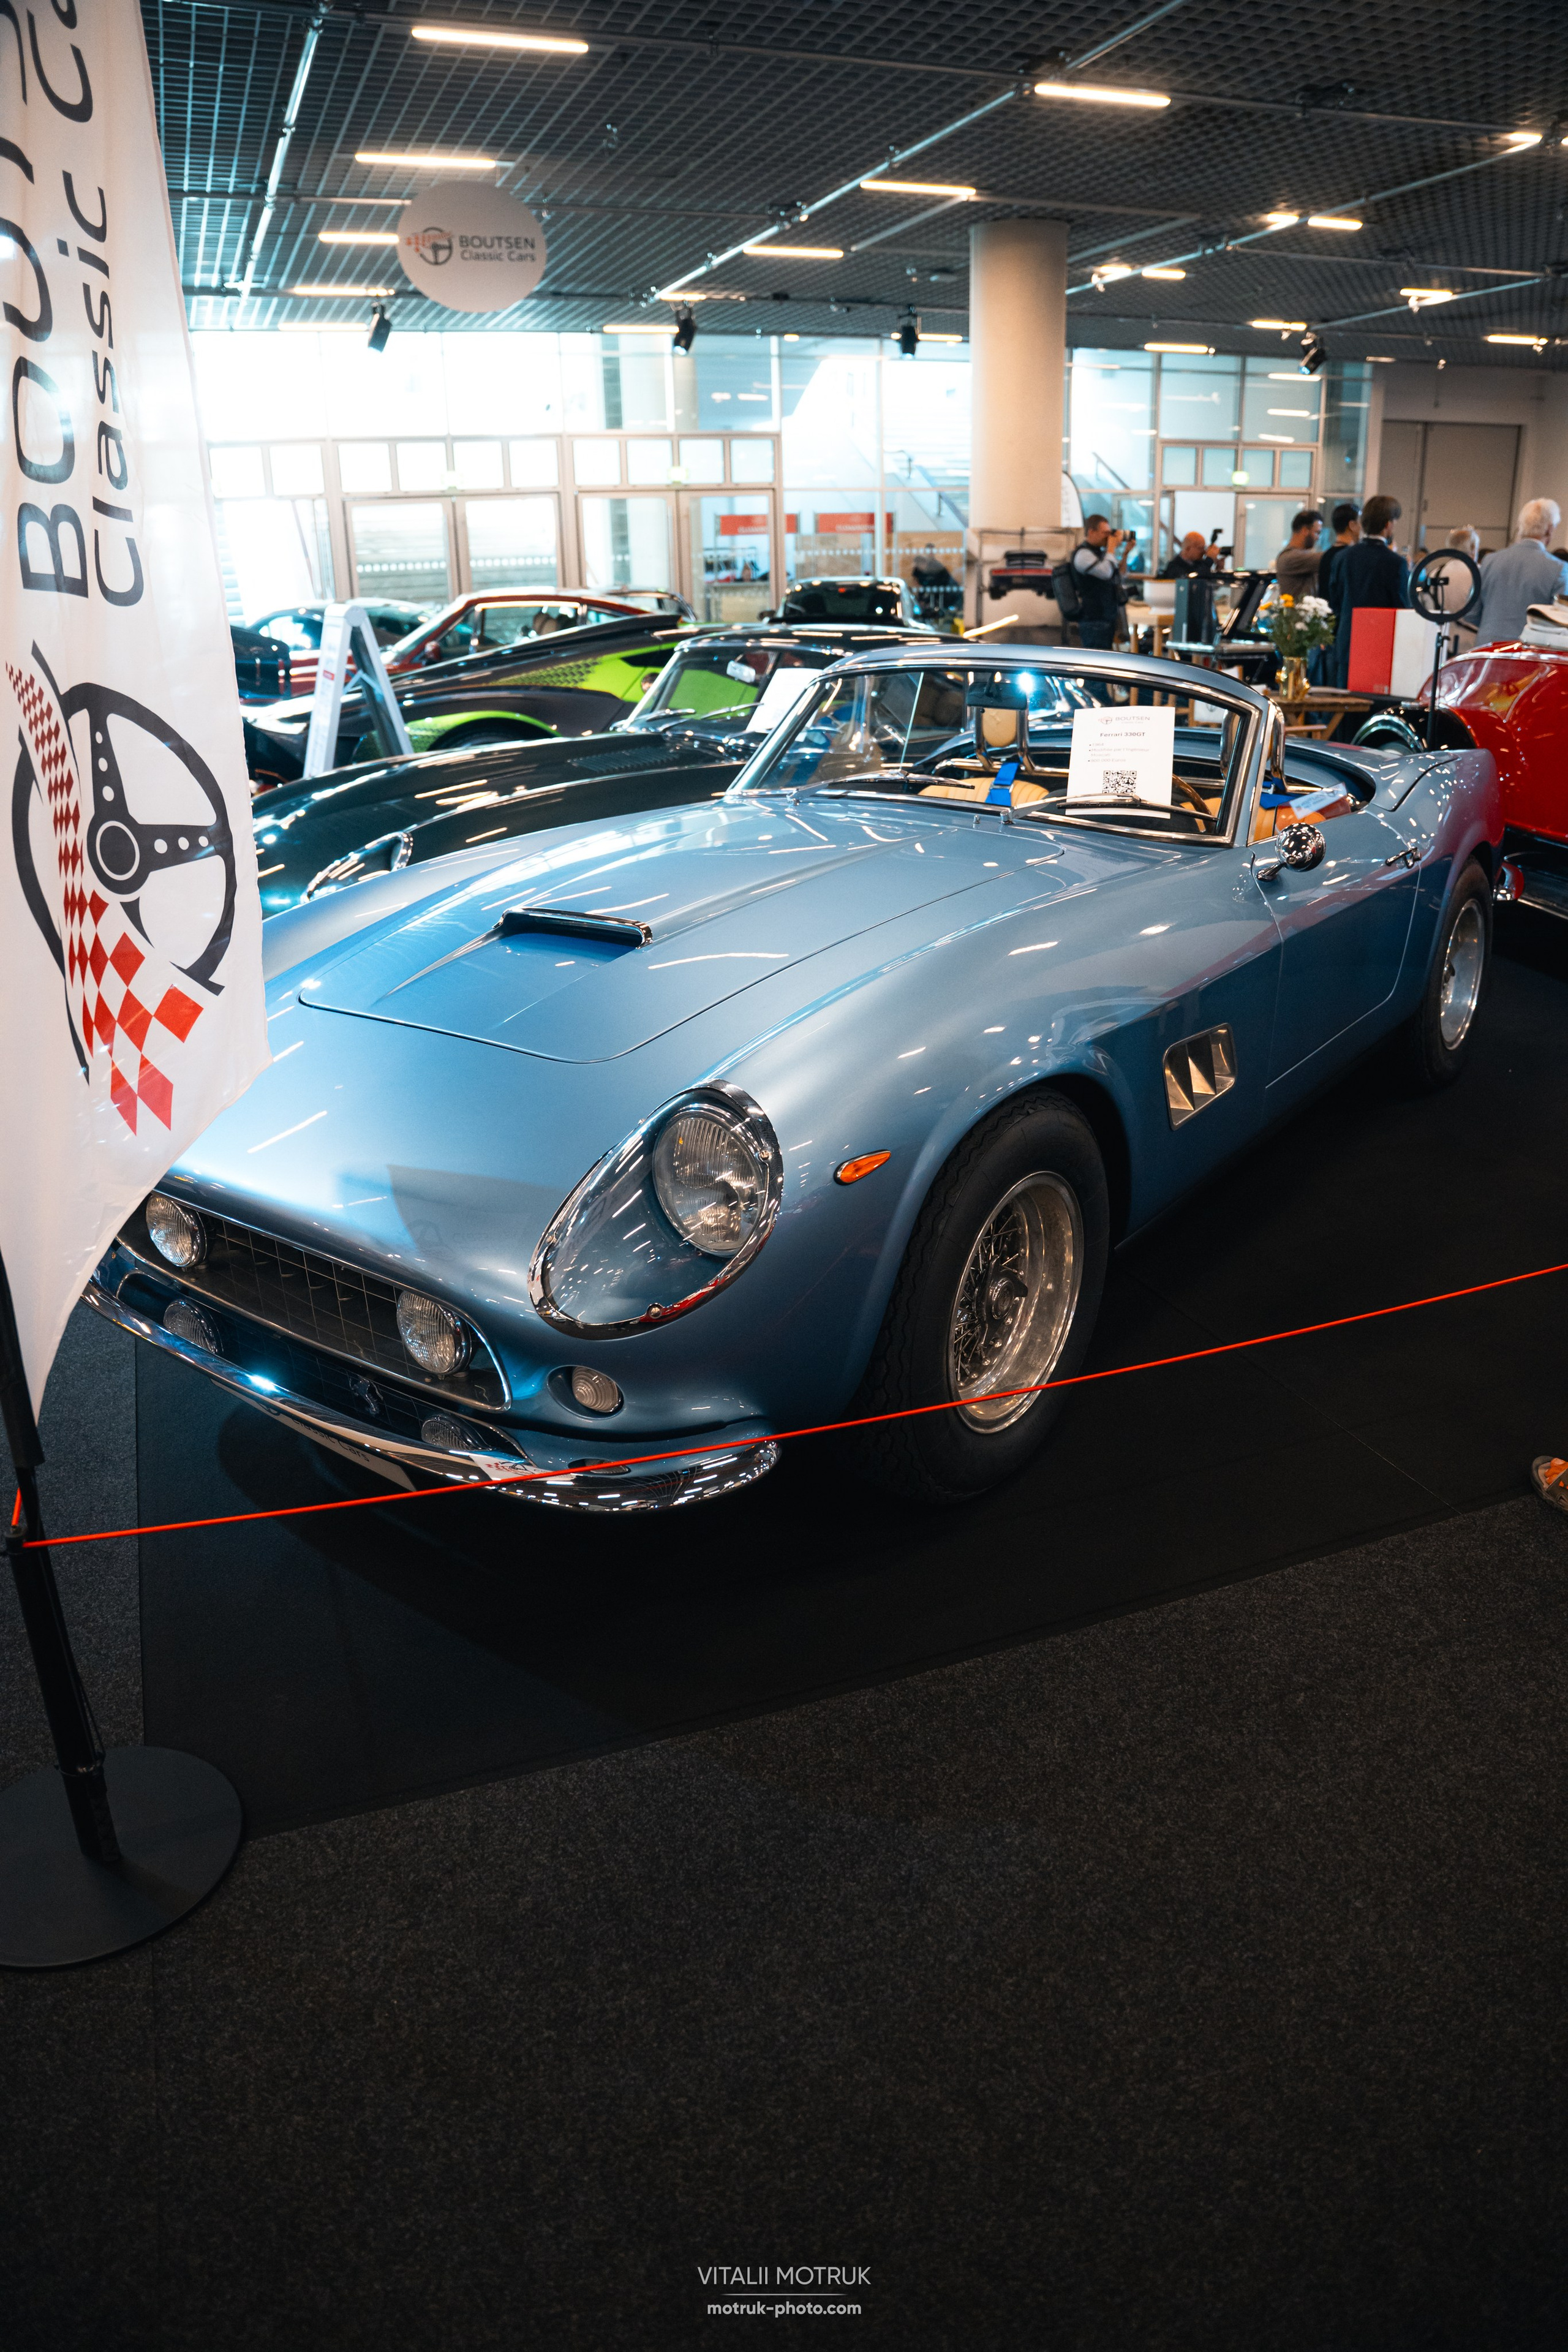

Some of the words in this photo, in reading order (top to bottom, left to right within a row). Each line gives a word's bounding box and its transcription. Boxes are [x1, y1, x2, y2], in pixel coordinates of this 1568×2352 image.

[0, 0, 88, 598] BOU
[458, 235, 535, 249] BOUTSEN
[460, 249, 503, 262] Classic
[507, 250, 537, 262] Cars
[57, 170, 145, 607] Classic
